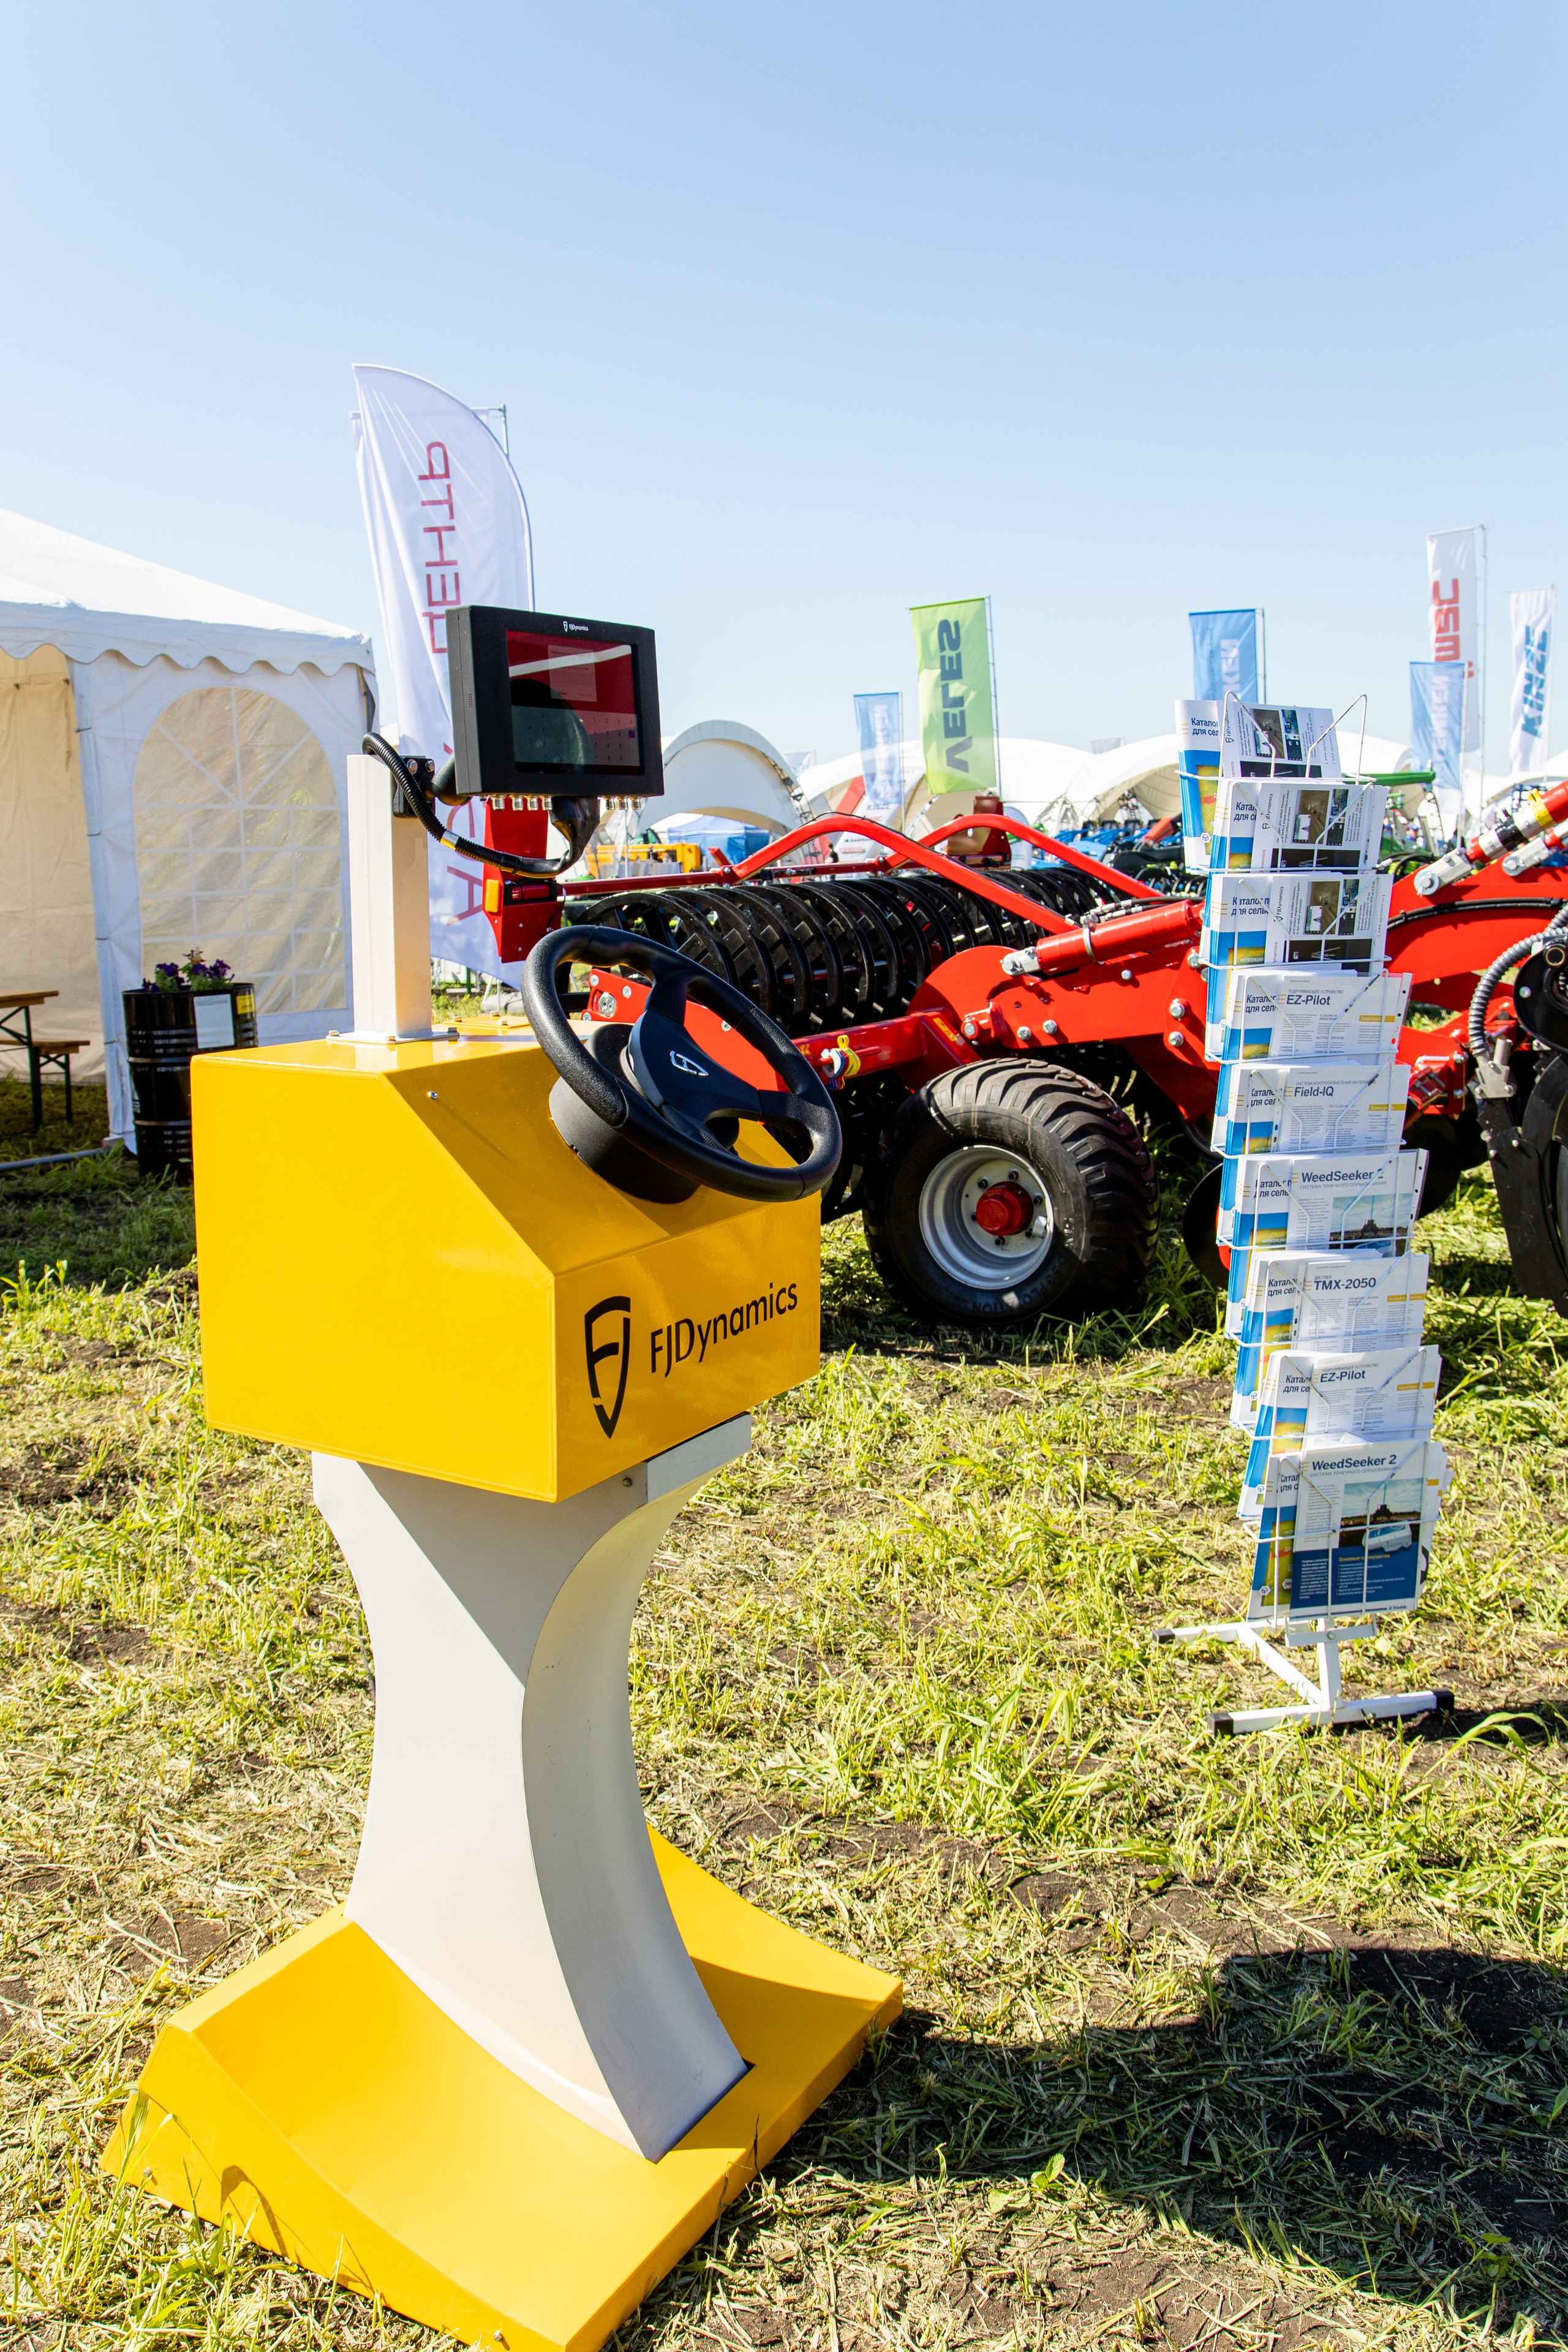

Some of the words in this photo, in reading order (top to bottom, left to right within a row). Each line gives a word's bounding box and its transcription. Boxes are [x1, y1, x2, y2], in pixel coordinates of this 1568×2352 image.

[1286, 995, 1331, 1005] EZ-Pilot
[1294, 1086, 1334, 1097] Field-IQ
[1302, 1170, 1374, 1183] WeedSeeker
[1314, 1278, 1376, 1291] TMX-2050
[651, 1282, 797, 1378] FJDynamics
[1320, 1370, 1366, 1383] EZ-Pilot
[1312, 1456, 1386, 1471] WeedSeeker
[1389, 1454, 1396, 1464] 2
